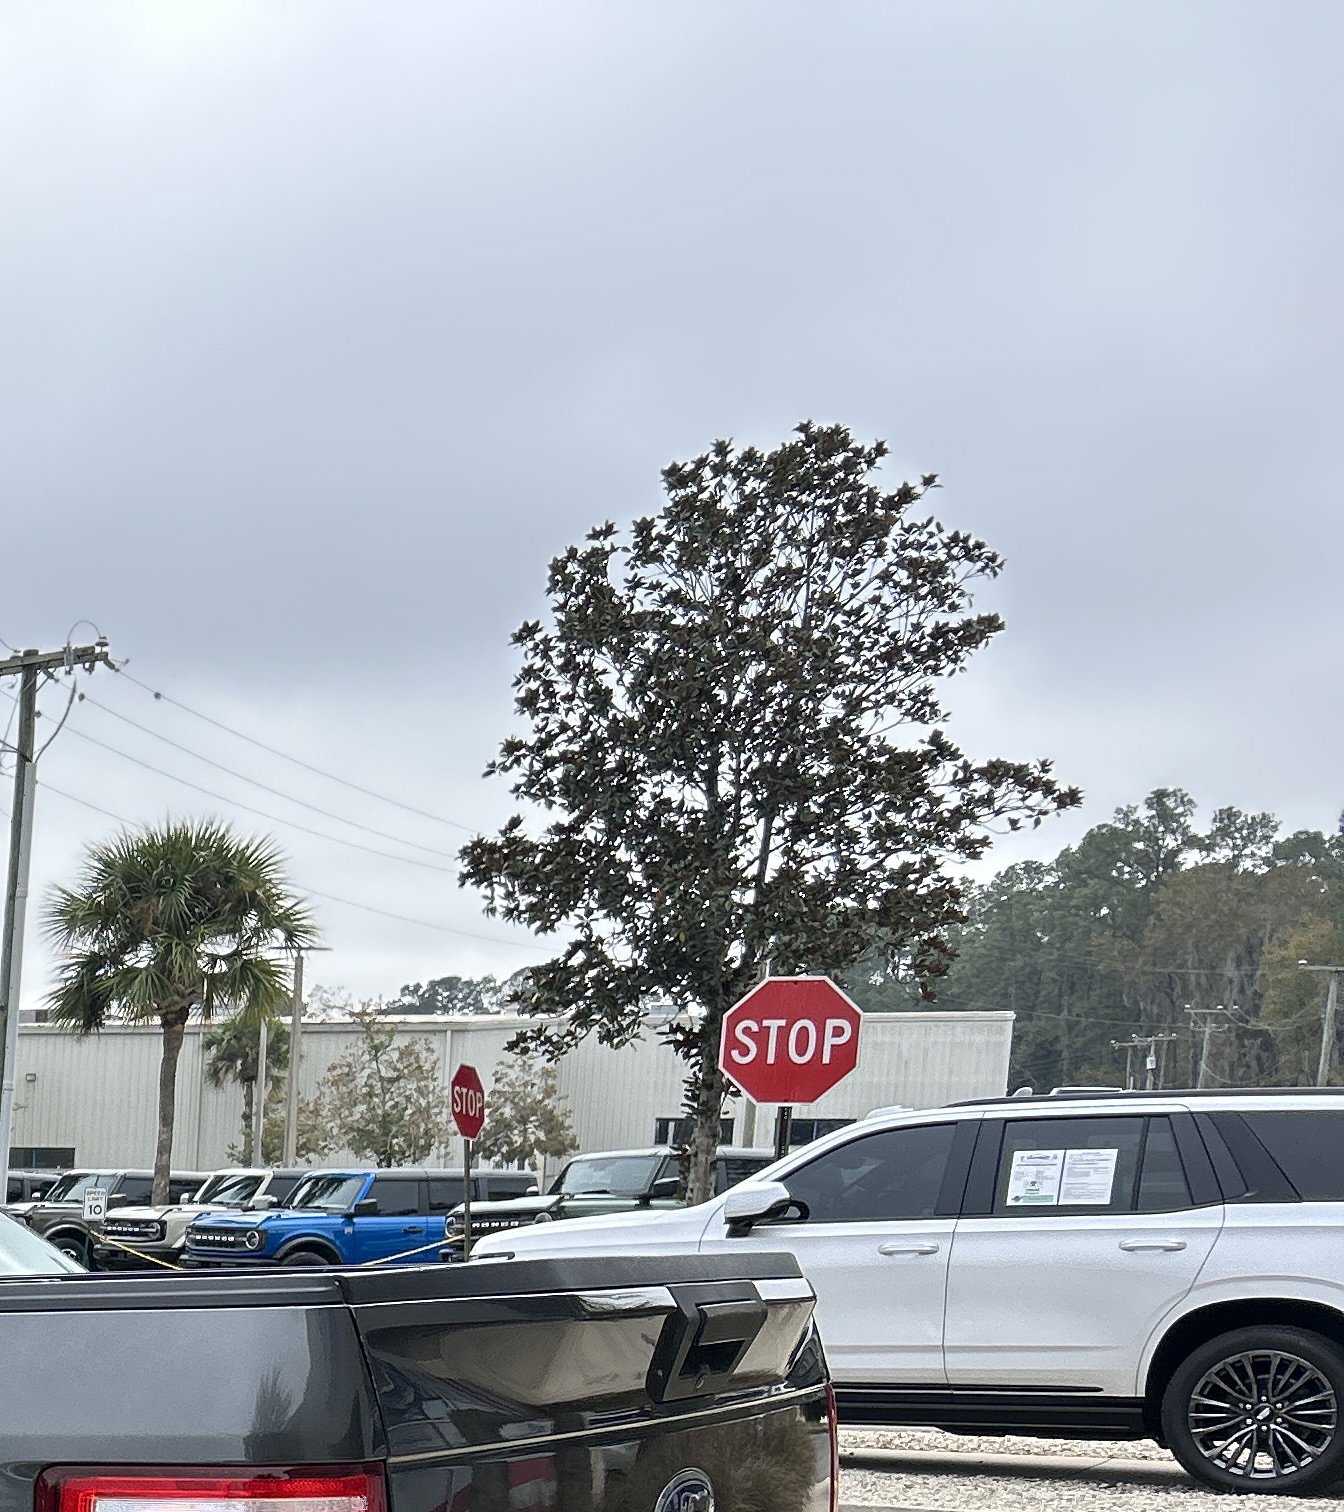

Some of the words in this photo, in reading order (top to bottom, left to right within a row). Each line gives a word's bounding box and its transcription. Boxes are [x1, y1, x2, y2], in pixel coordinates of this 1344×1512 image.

[730, 1018, 852, 1065] STOP
[453, 1085, 483, 1118] STOP
[89, 1204, 102, 1215] 10
